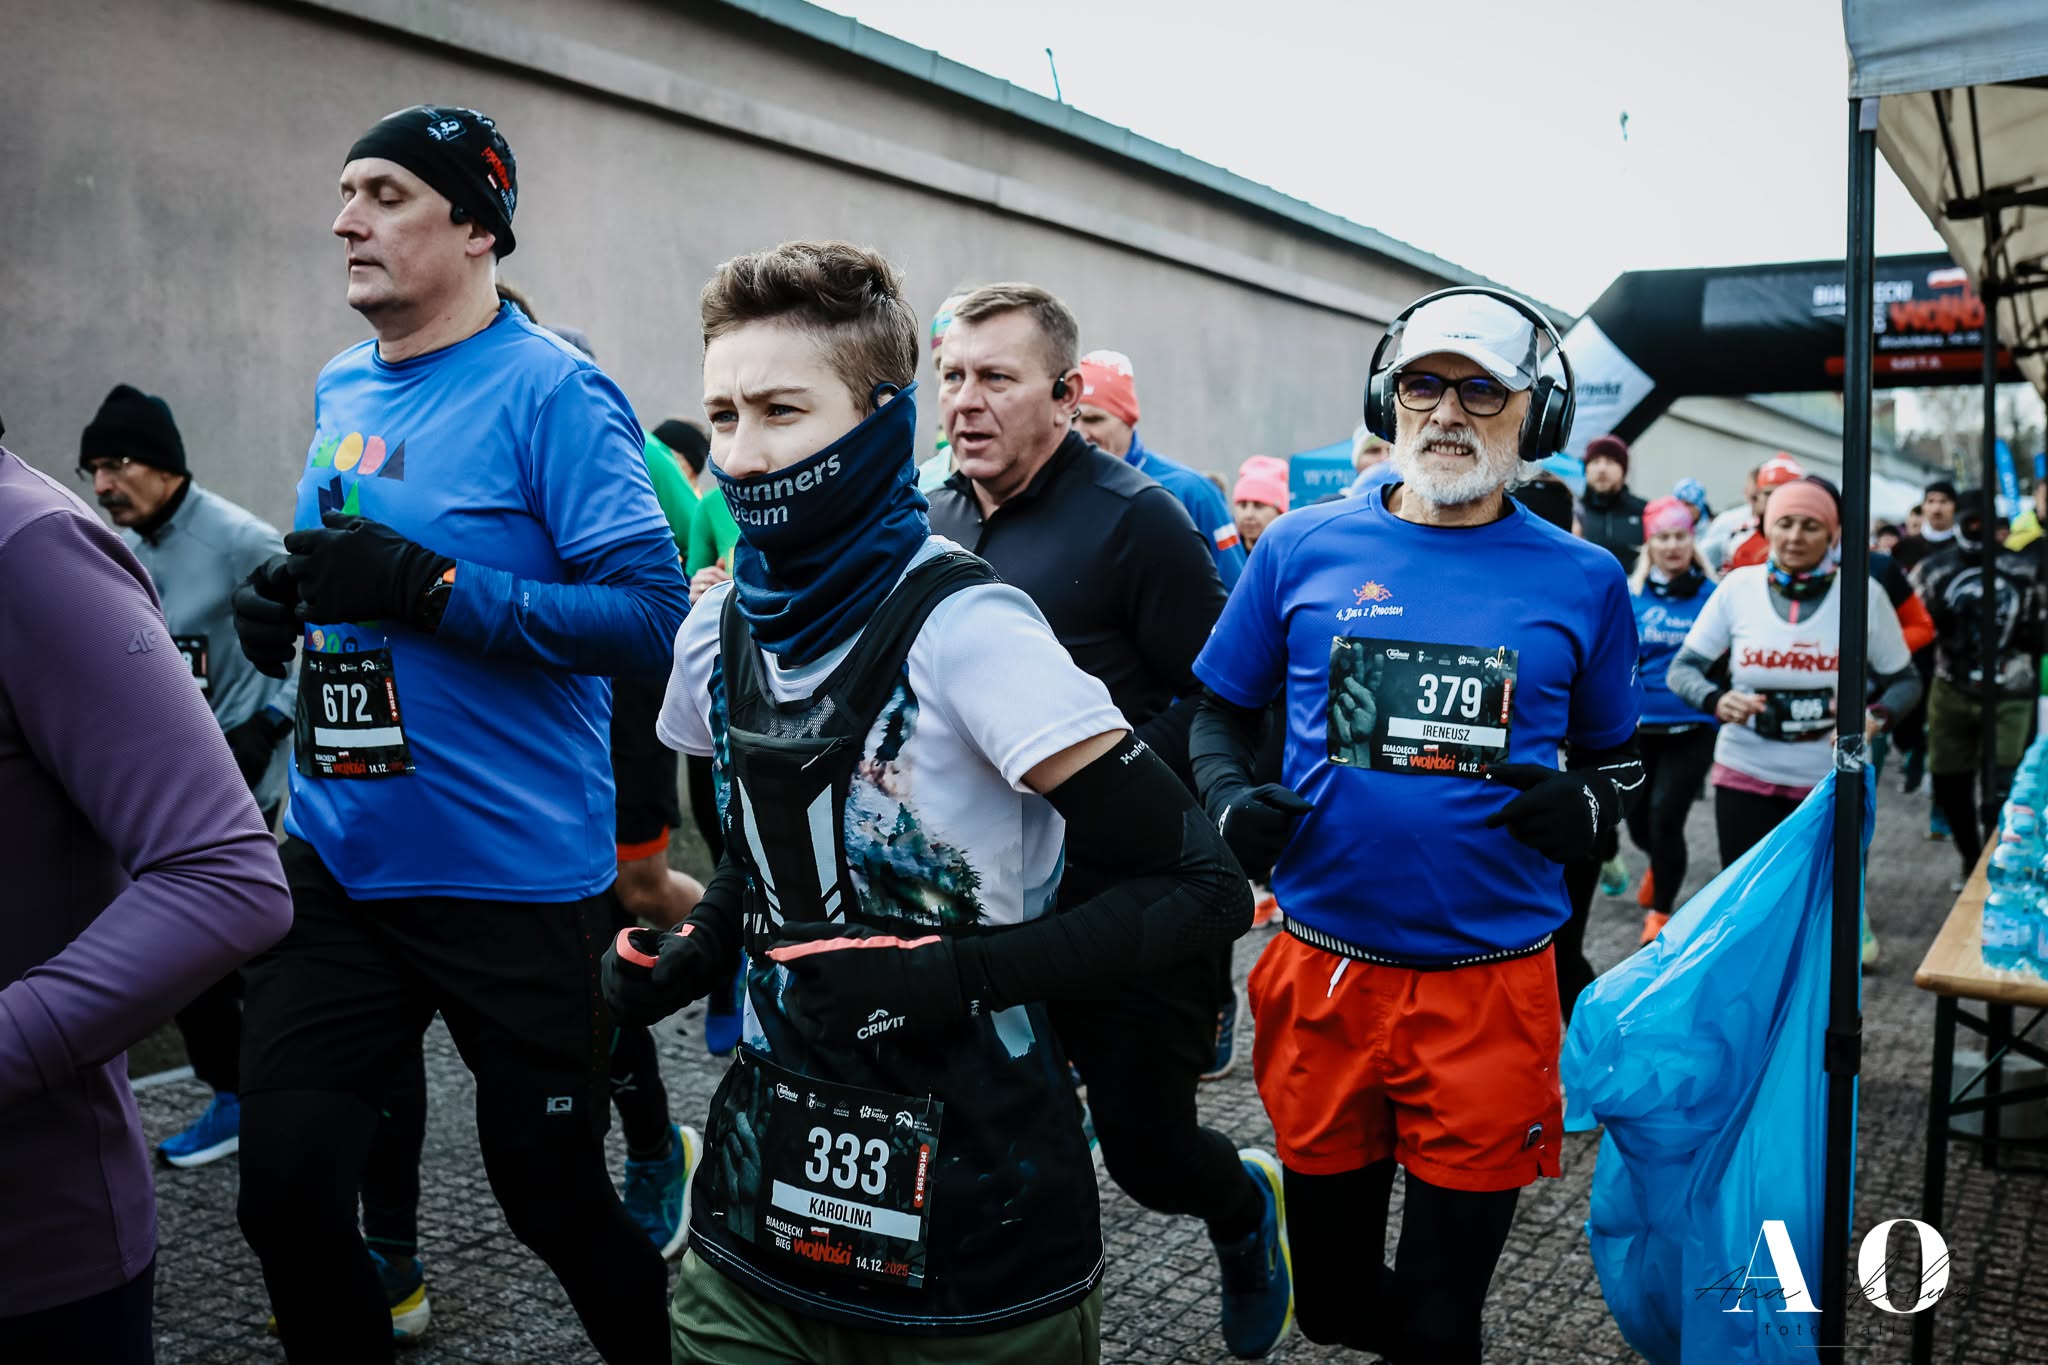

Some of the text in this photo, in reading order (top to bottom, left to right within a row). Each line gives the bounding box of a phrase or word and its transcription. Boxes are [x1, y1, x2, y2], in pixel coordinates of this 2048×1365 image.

[311, 431, 406, 481] MODA
[322, 683, 373, 723] 672
[1416, 673, 1483, 719] 379
[1422, 724, 1471, 742] IRENEUSZ
[1382, 744, 1418, 755] BIAŁOŁĘCKI
[1392, 757, 1408, 767] BIEG
[856, 1015, 906, 1040] CRIVIT
[804, 1126, 890, 1196] 333
[765, 1215, 804, 1238] BIAŁOŁĘCKI
[809, 1197, 873, 1228] KAROLINA
[775, 1236, 791, 1251] BIEG
[855, 1255, 909, 1277] 14.12.2025
